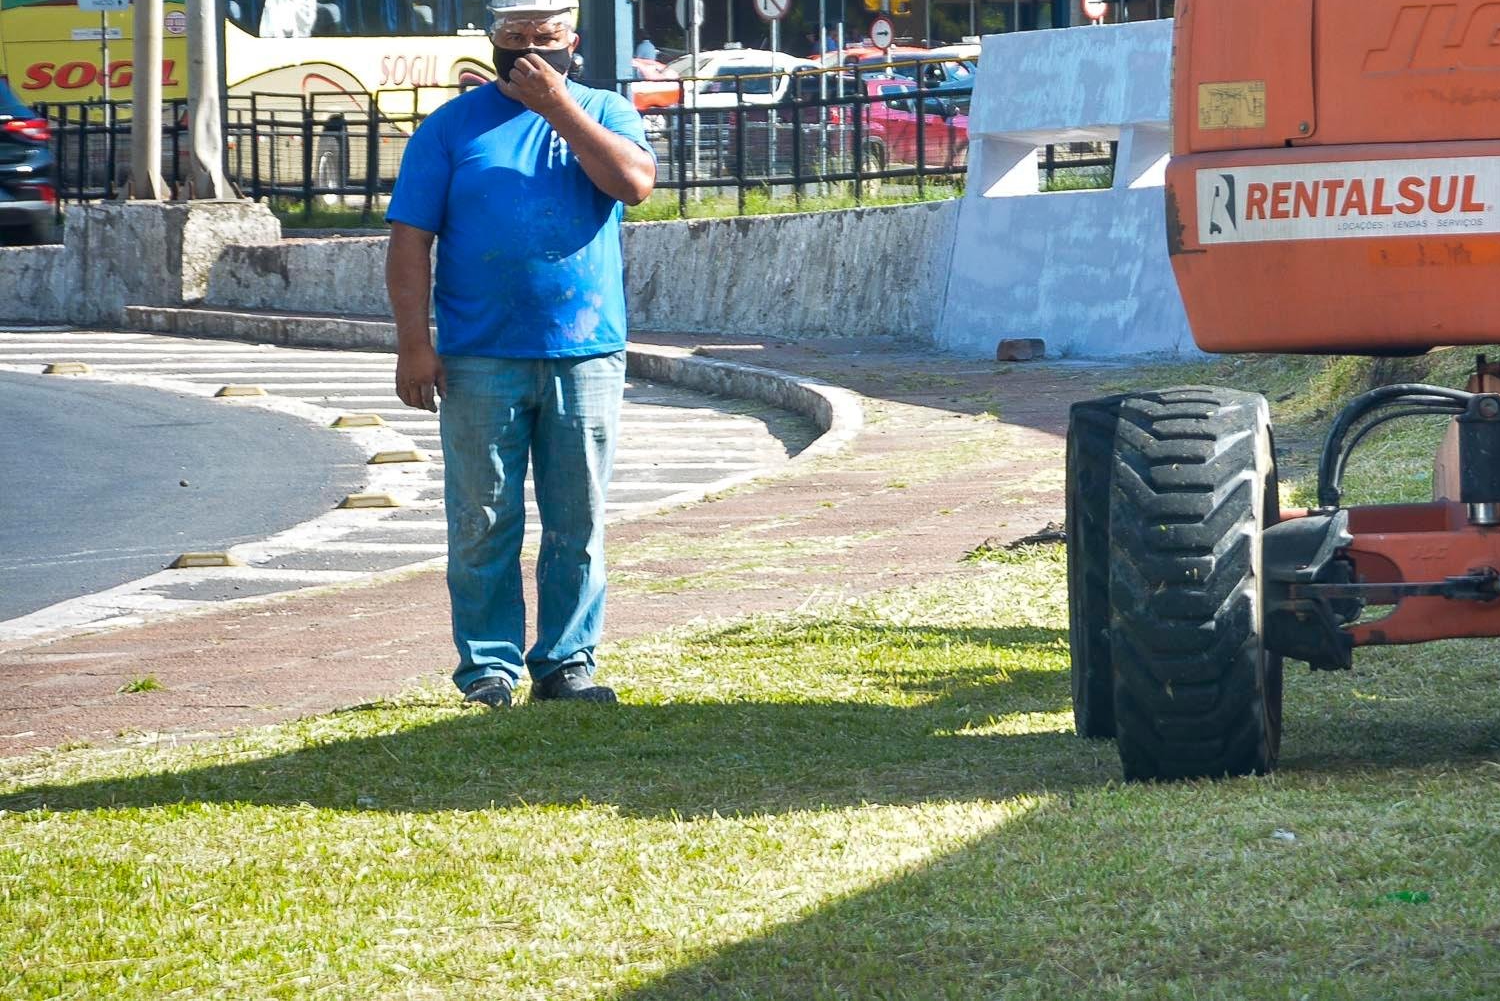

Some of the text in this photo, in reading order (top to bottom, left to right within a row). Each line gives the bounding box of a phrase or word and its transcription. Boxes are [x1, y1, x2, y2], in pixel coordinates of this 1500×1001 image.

[21, 58, 178, 90] SOGL
[379, 54, 440, 87] SOGIL
[1245, 174, 1486, 221] RENTALSUL
[1392, 219, 1428, 229] VENDAS
